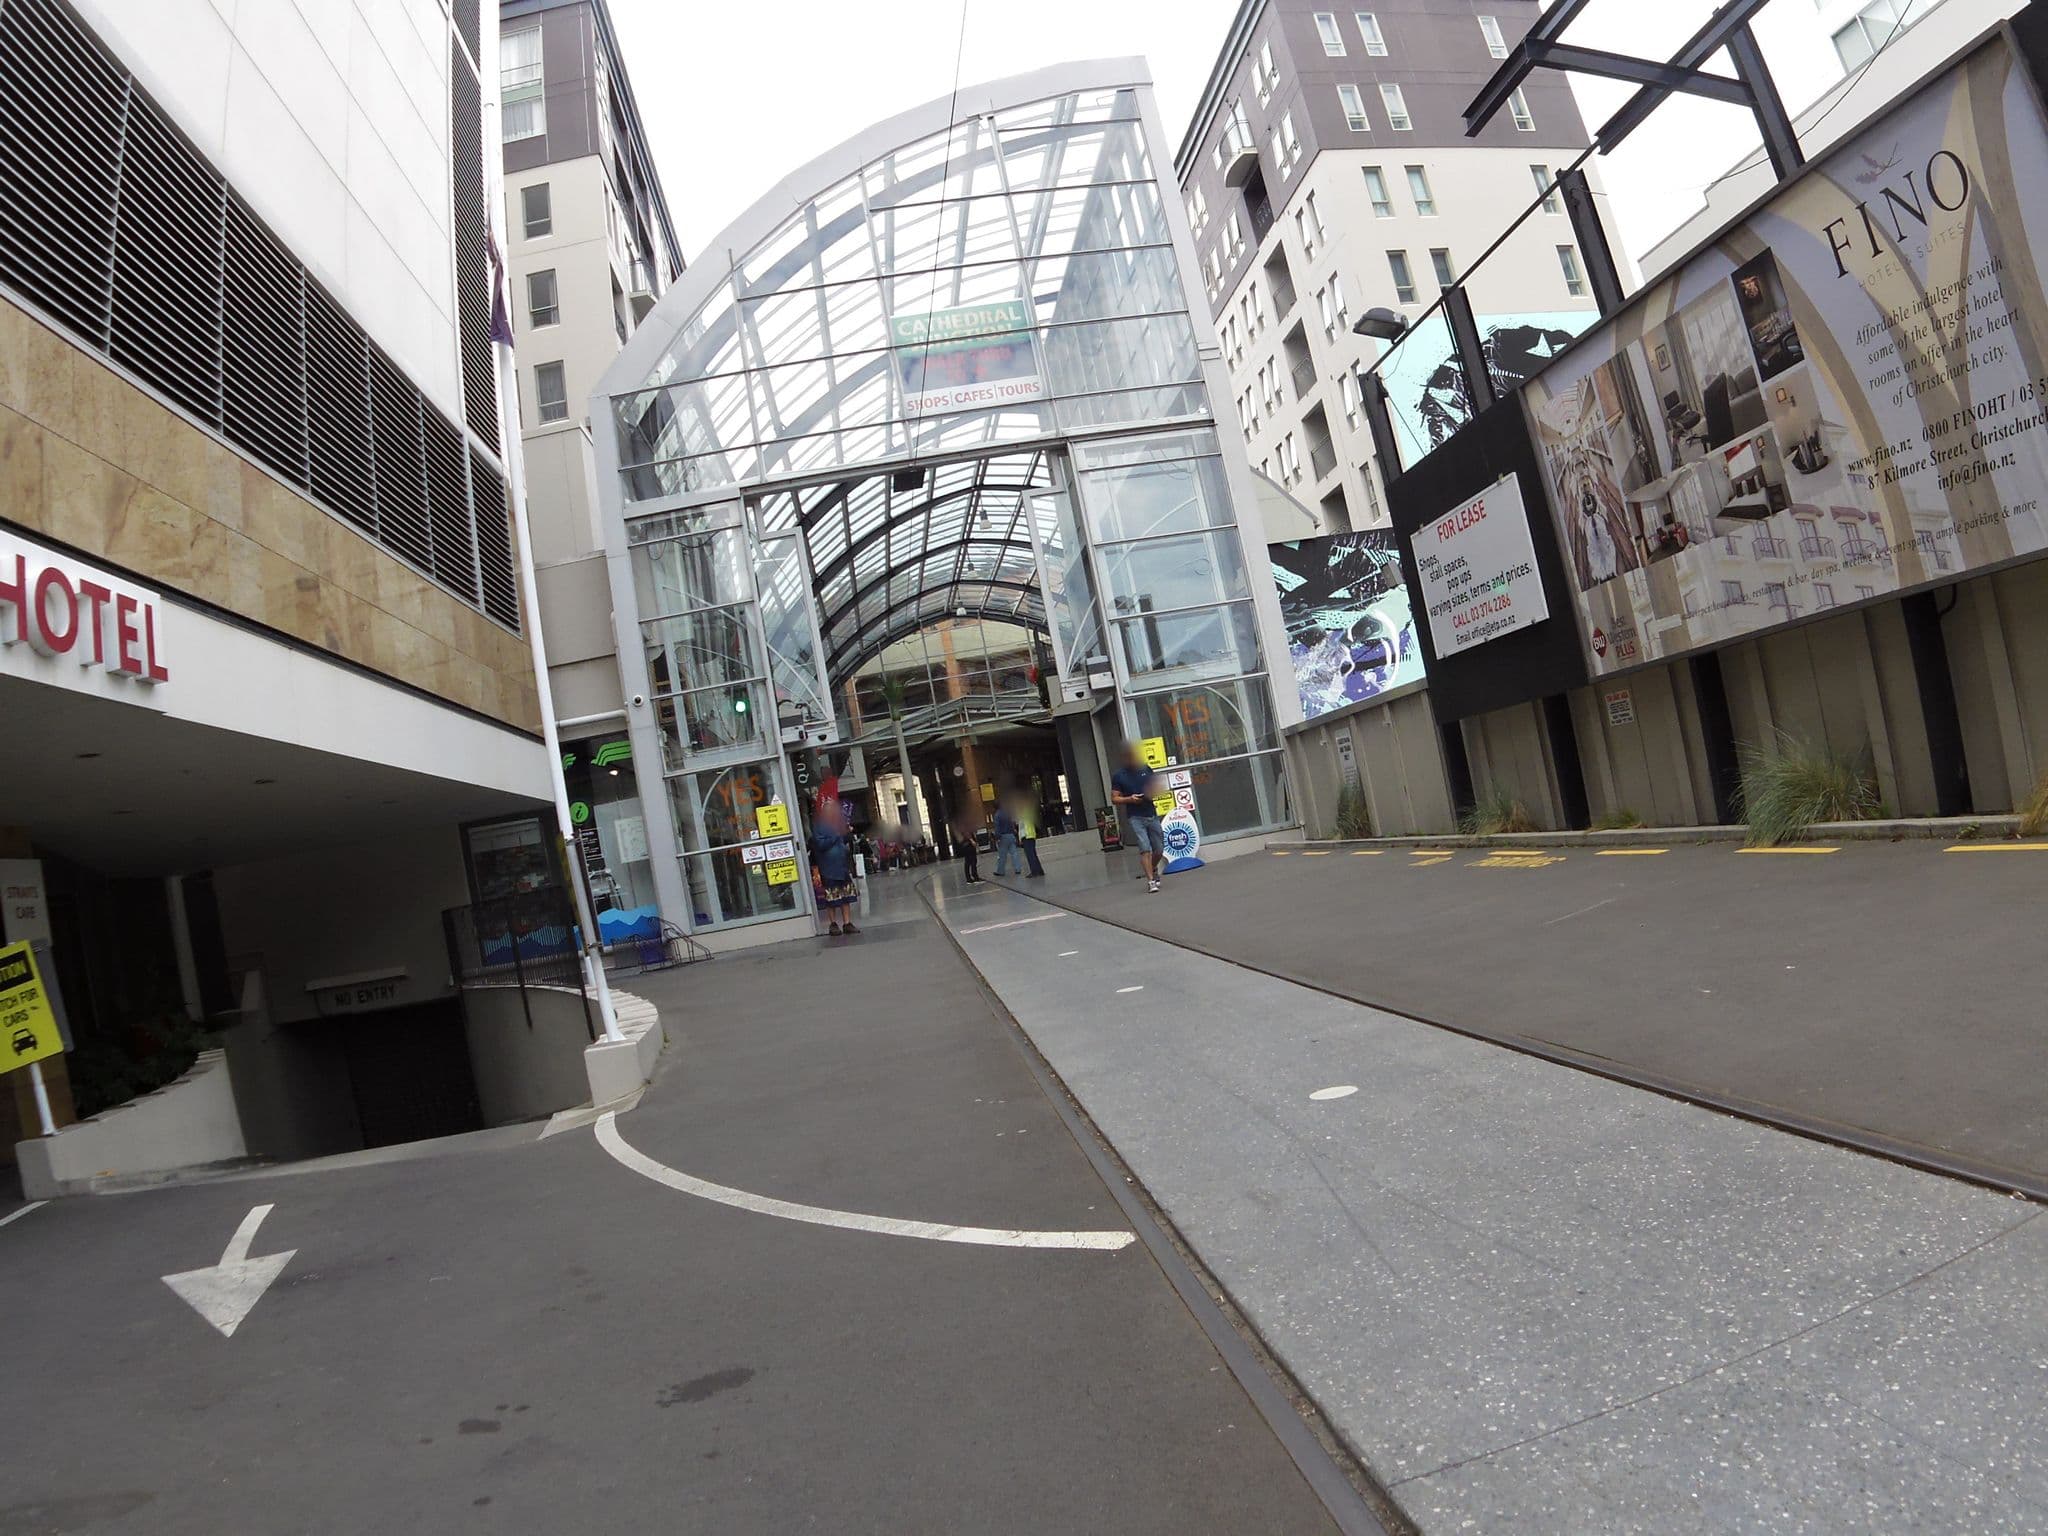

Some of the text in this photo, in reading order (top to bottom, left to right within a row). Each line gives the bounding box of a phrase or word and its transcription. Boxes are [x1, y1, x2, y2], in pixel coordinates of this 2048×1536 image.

[1822, 150, 1969, 279] FINO
[1917, 222, 1967, 259] SUITES
[1856, 254, 2003, 347] Affordable indulgence with
[898, 306, 1021, 336] CATHEDRAL
[1867, 282, 2004, 365] some of the largest hotel
[1869, 308, 2020, 391] rooms on offer in the heart
[1892, 343, 2008, 408] of Christchurch city.
[907, 381, 1041, 412] SHOPS CAFES TOURS
[1847, 438, 1914, 473] www.fino.nz
[1922, 418, 1949, 443] 0800
[1953, 394, 2007, 431] FINOHT
[2020, 383, 2035, 404] 03
[1867, 472, 1880, 491] 87
[1883, 457, 1927, 485] Kilmore
[1929, 442, 1968, 467] Street,
[1937, 452, 2017, 491] info@fino.nz
[1437, 499, 1487, 543] FOR LEASE
[1811, 562, 1824, 581] day
[1842, 552, 1873, 569] meeting
[1935, 523, 1962, 541] ample
[1963, 510, 2000, 534] parking
[2001, 505, 2011, 519] &
[2013, 500, 2037, 516] more
[1444, 555, 1468, 578] spaces,
[1447, 569, 1472, 594] pop ups
[1451, 591, 1471, 609] sizes,
[1469, 580, 1492, 599] terms
[1491, 571, 1505, 589] and
[1506, 562, 1533, 585] prices.
[0, 554, 168, 682] HOTEL
[1452, 610, 1471, 630] CALL
[1470, 606, 1480, 621] 03
[1480, 601, 1494, 618] 374
[1456, 630, 1472, 646] Email
[1162, 694, 1209, 727] YES
[715, 774, 764, 808] YES
[1168, 832, 1187, 842] fresh
[1172, 839, 1187, 848] milk
